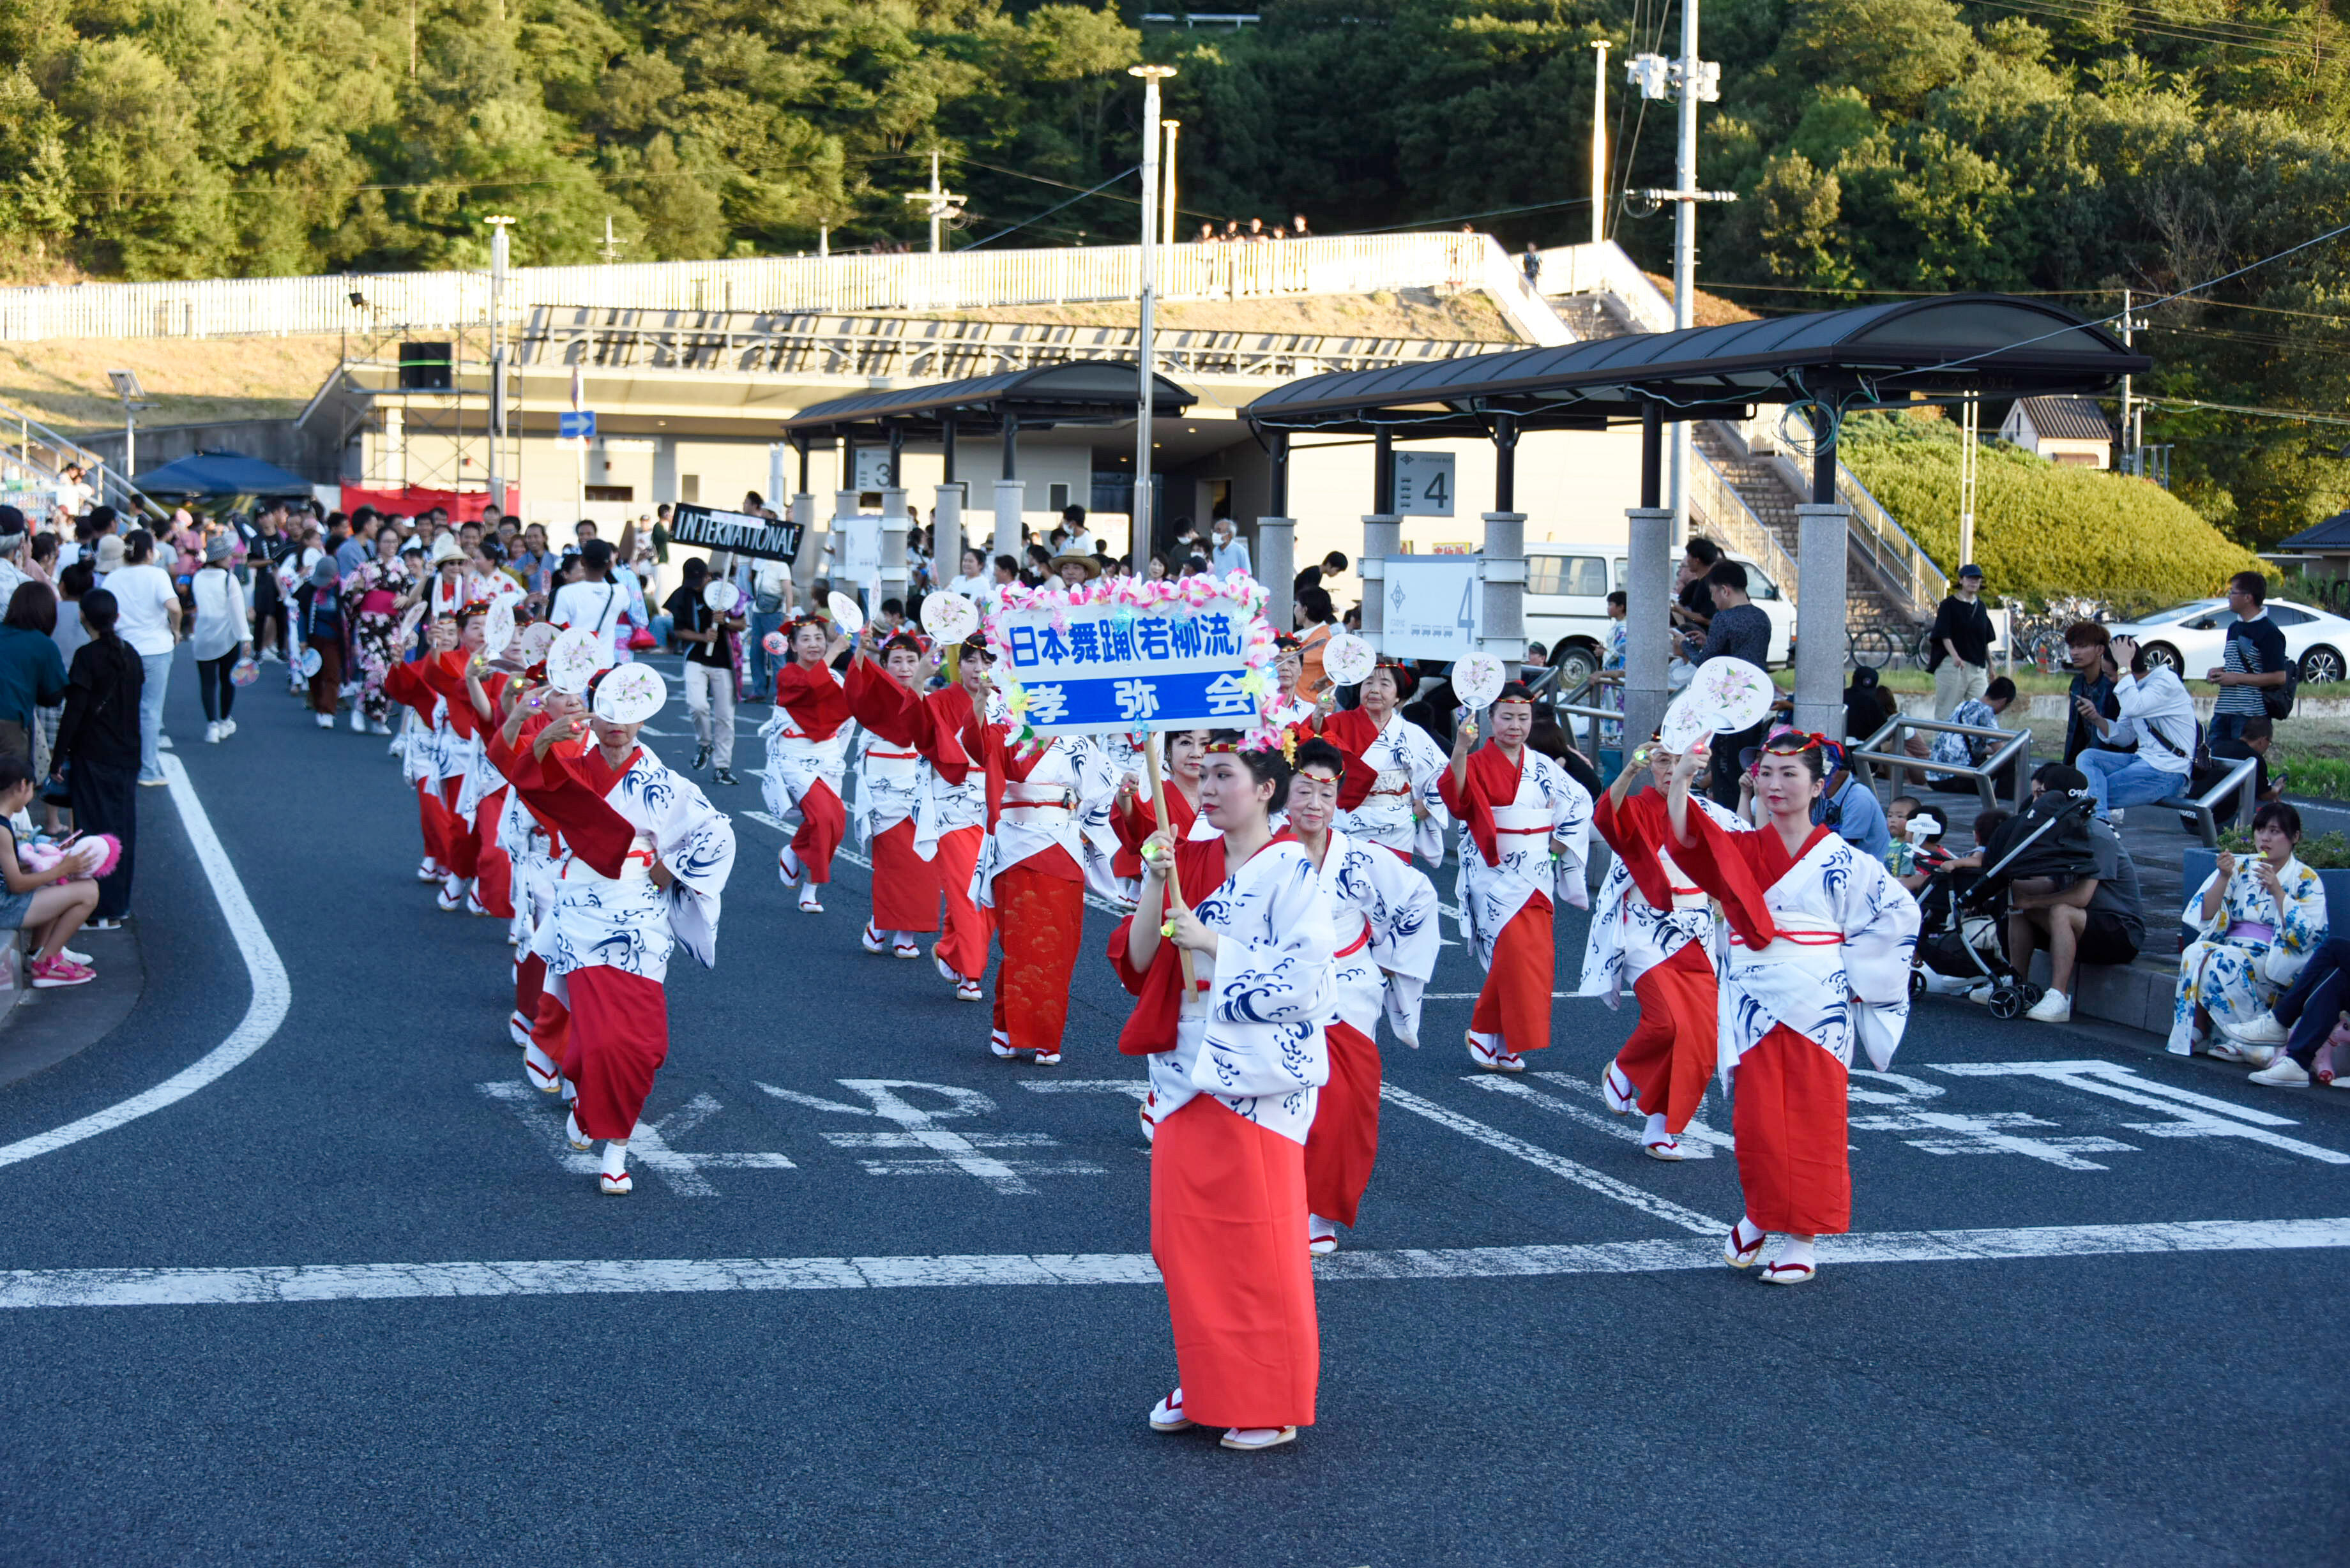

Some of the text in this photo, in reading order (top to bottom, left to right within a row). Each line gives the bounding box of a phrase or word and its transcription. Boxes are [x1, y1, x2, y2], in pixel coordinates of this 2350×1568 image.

[876, 463, 891, 487] 3
[1423, 472, 1448, 509] 4
[674, 509, 795, 556] INTERNATIONAL
[1457, 577, 1475, 645] 4
